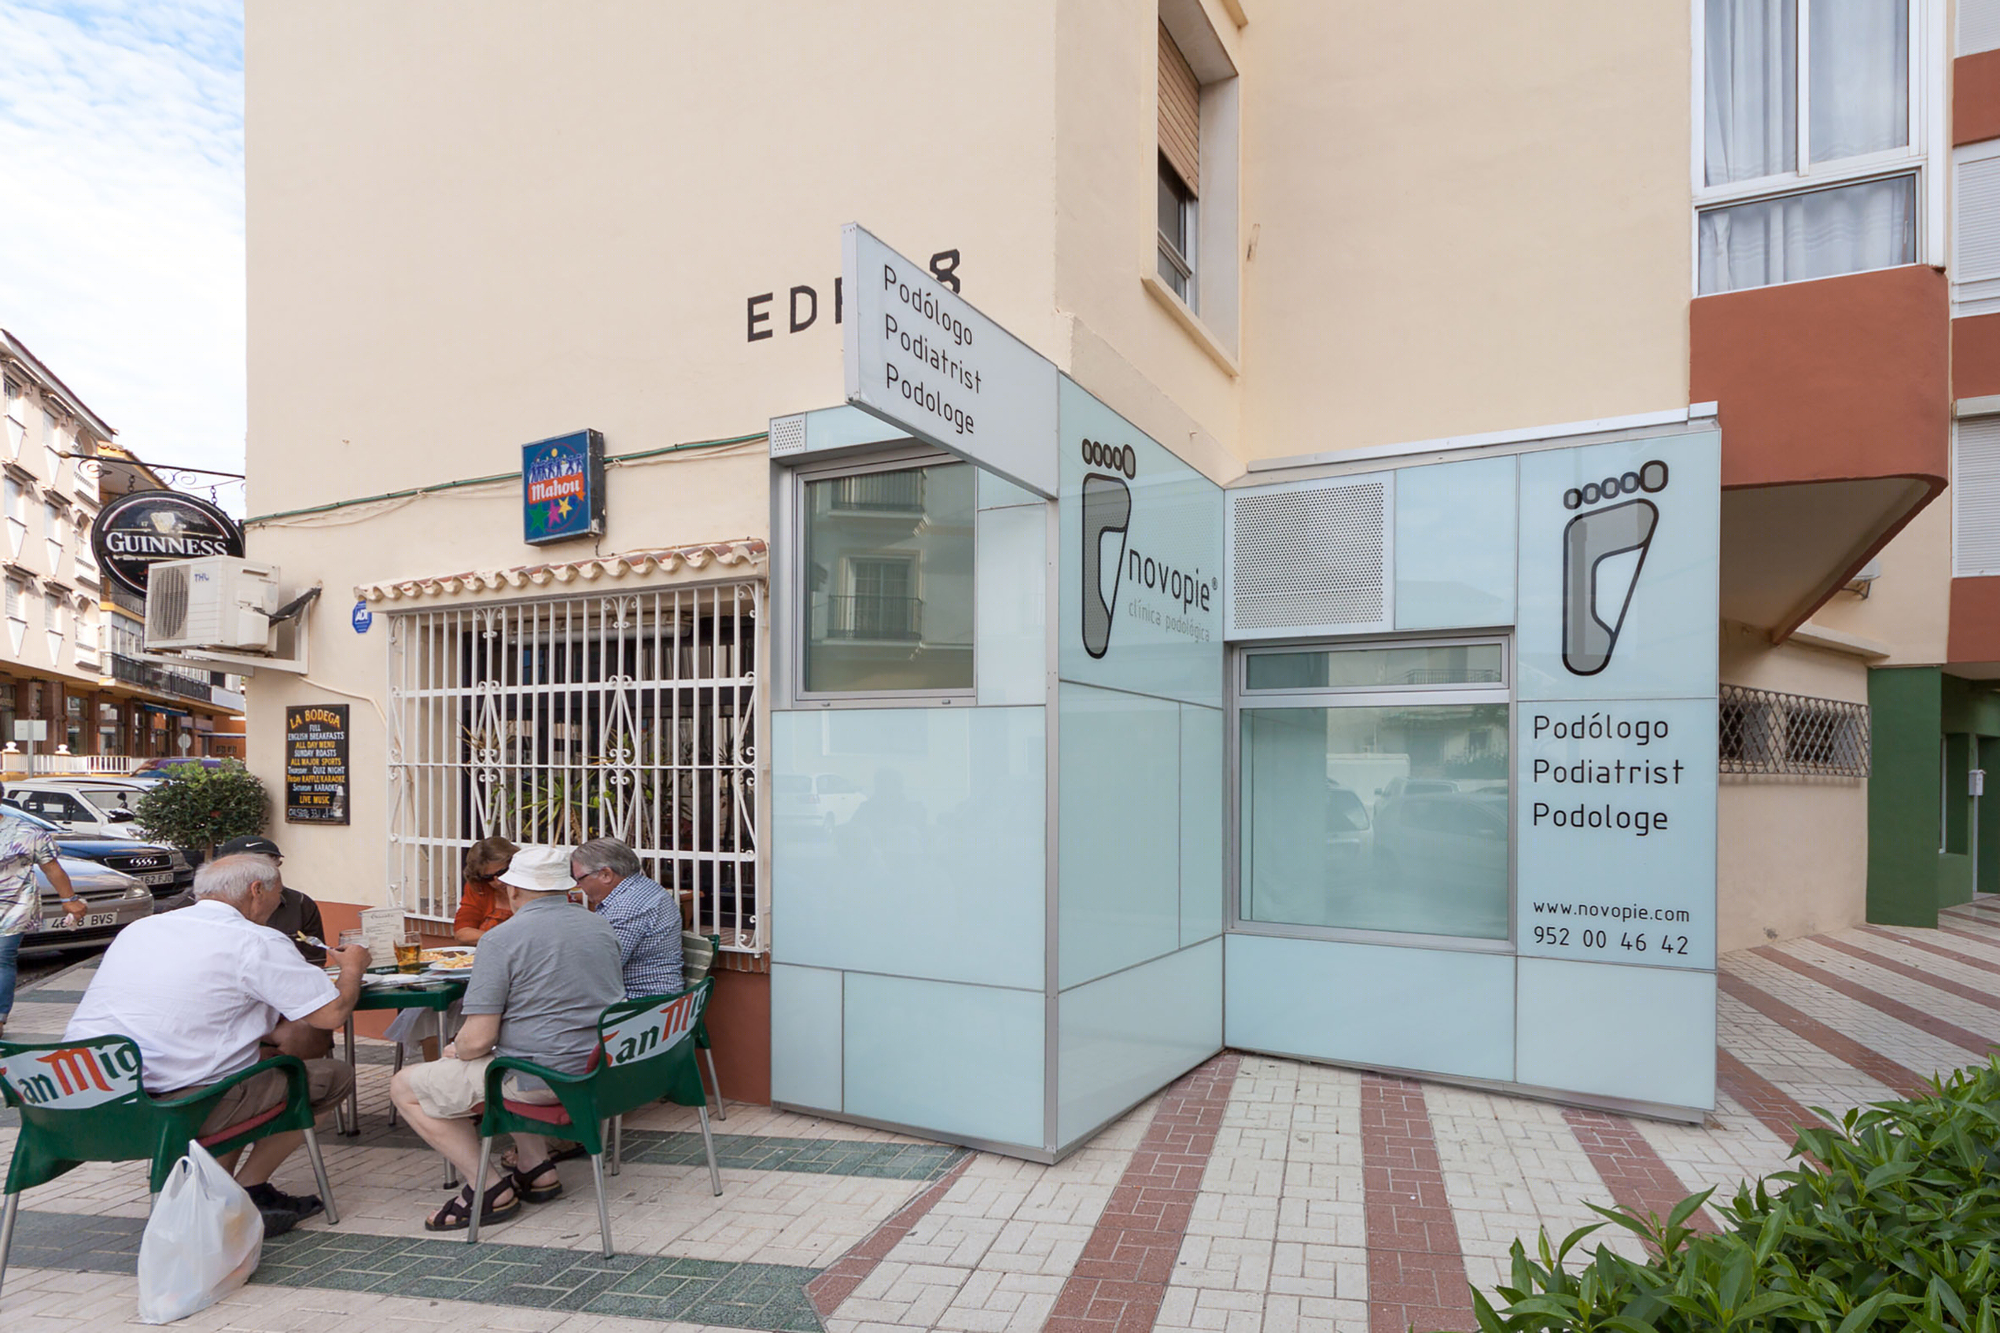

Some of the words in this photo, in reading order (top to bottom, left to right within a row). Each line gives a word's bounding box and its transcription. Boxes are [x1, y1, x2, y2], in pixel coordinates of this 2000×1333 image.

[883, 264, 973, 346] Podólogo
[885, 313, 982, 394] Podiatrist
[886, 362, 975, 434] Podologe
[531, 479, 581, 501] Mahou
[105, 531, 228, 556] GUINNESS
[1128, 598, 1162, 625] clínica
[1165, 614, 1210, 643] podológica
[289, 714, 302, 729] LA
[305, 708, 341, 728] BODEGA
[309, 724, 321, 732] FULL
[1533, 712, 1669, 746] Podólogo
[288, 733, 308, 741] ENGLISH
[309, 732, 345, 740] BREAKFASTS
[295, 741, 306, 749] ALL
[307, 741, 319, 749] DAY
[290, 758, 301, 766] ALL
[301, 758, 320, 766] MAJOR
[321, 758, 342, 766] SPORTS
[294, 749, 314, 757] SUNDAY
[315, 749, 337, 757] ROASTS
[312, 766, 327, 775] QUIZ
[327, 766, 345, 774] NIGHT
[1533, 758, 1685, 785] Podiatrist
[299, 795, 312, 804] LIVE
[313, 795, 330, 804] MUSIC
[1533, 802, 1669, 837] Podologe
[90, 913, 114, 926] BVS
[1533, 901, 1690, 923] www.novopie.com
[1533, 925, 1571, 946] 952
[1583, 929, 1607, 949] 00
[1620, 931, 1647, 952] 46
[1661, 934, 1689, 955] 42
